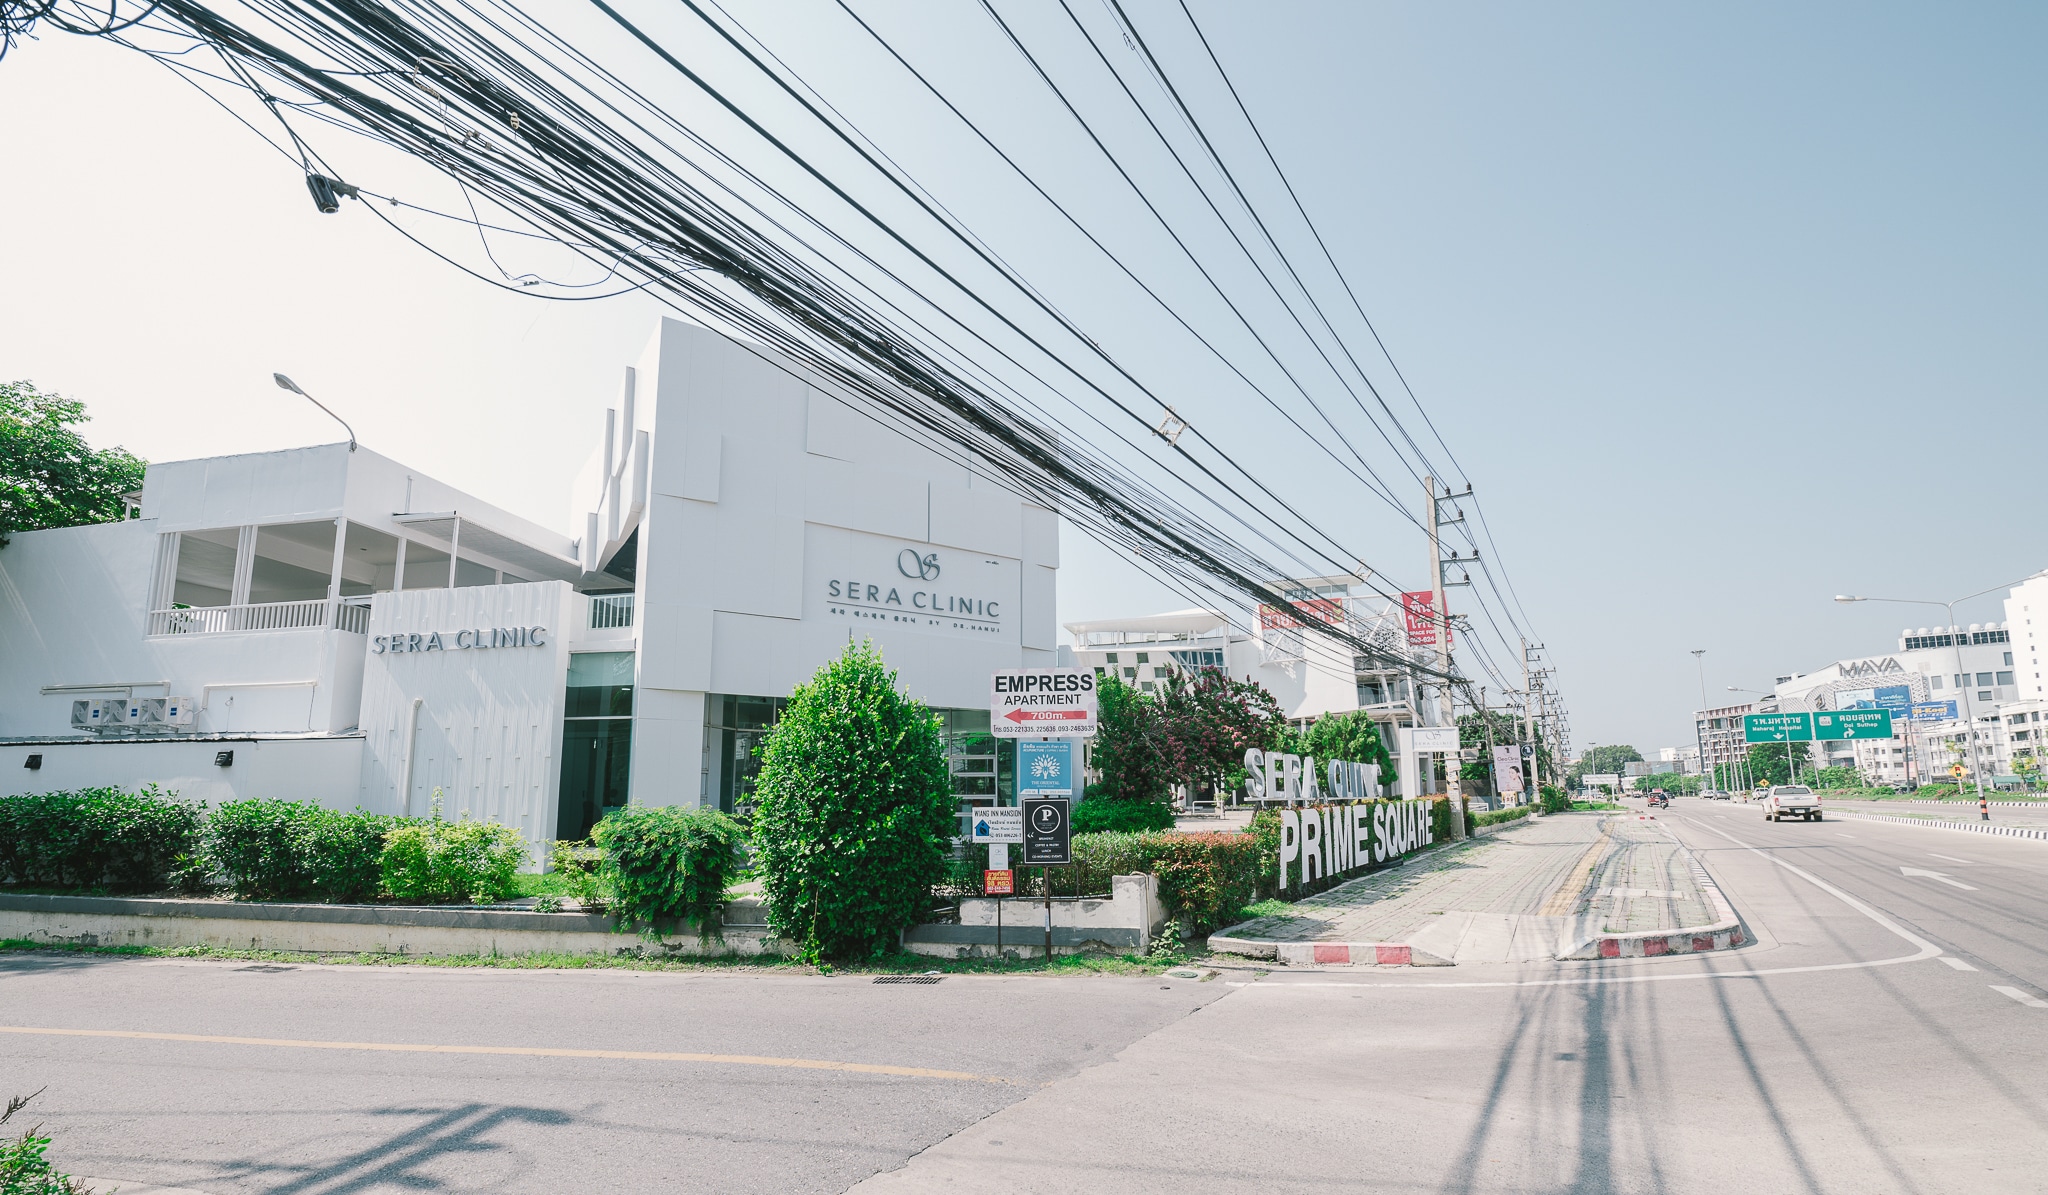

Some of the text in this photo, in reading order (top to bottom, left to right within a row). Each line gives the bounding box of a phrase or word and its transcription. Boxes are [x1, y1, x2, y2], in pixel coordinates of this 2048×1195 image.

[828, 579, 1000, 617] SERA CLINIC
[371, 625, 547, 655] SERA CLINIC
[1839, 657, 1905, 678] MAYA
[995, 674, 1093, 692] EMPRESS
[1004, 693, 1081, 705] APARTMENT
[1031, 712, 1067, 720] 700m.
[1244, 748, 1319, 798] SERA
[999, 809, 1022, 817] MANSION
[1041, 809, 1053, 821] P
[1279, 800, 1433, 890] PRIME SQUARE
